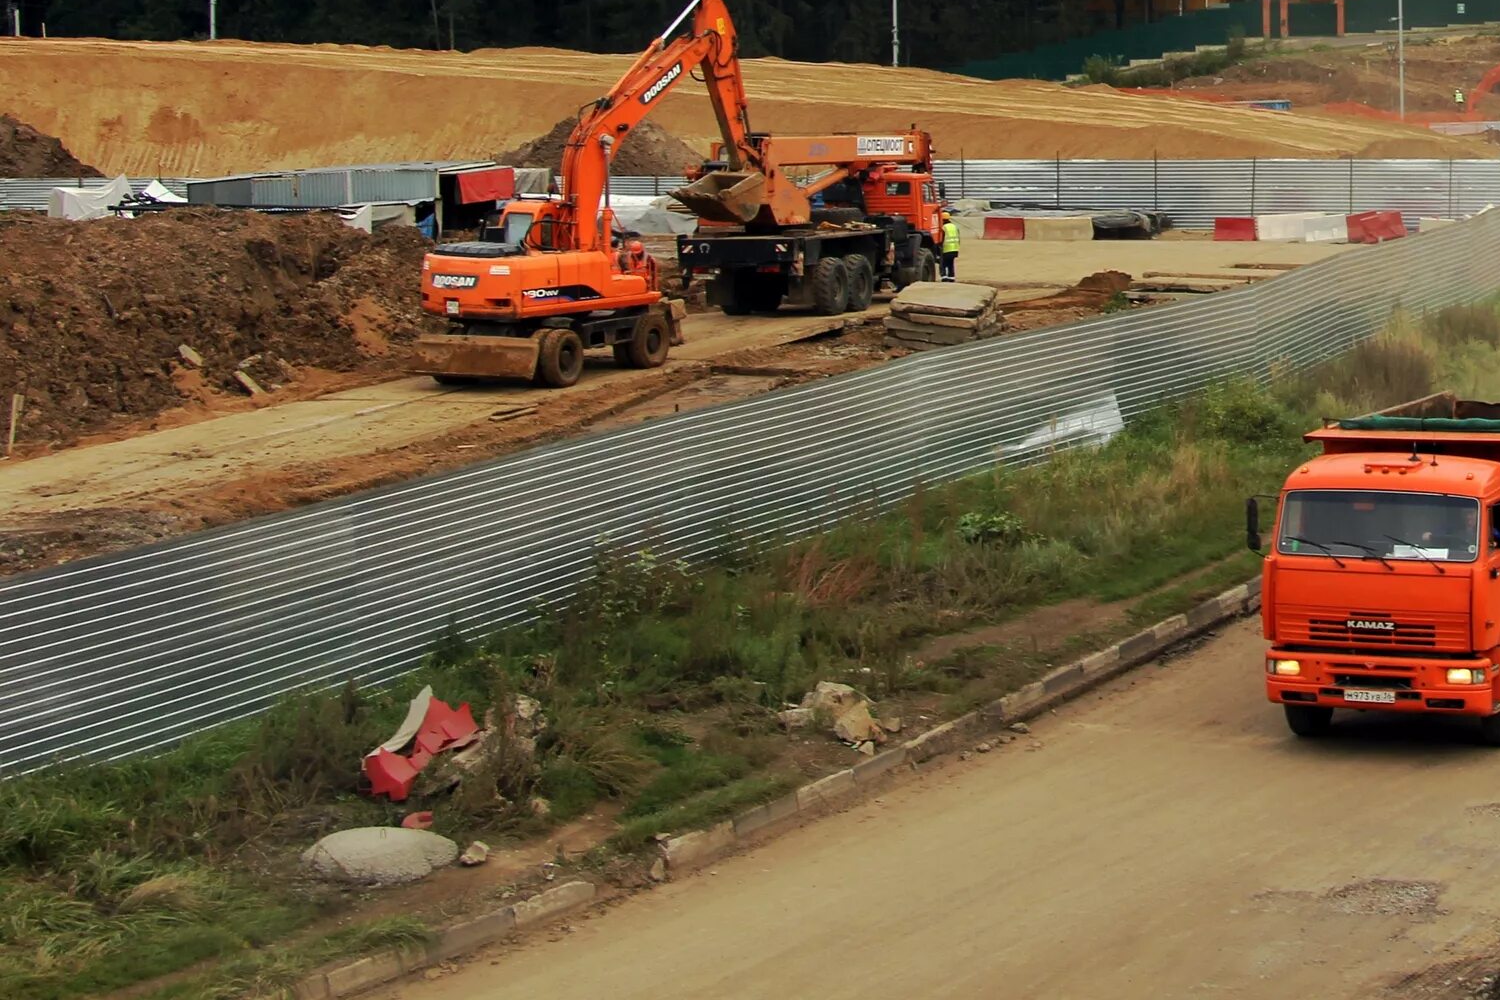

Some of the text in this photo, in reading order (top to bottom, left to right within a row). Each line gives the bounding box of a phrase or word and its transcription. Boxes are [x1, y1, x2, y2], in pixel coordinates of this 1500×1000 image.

[643, 63, 682, 103] DOOSAN
[866, 138, 904, 153] СПЕЦМОСТ
[432, 275, 477, 288] DOOSAN
[1347, 620, 1395, 630] KAMAZ
